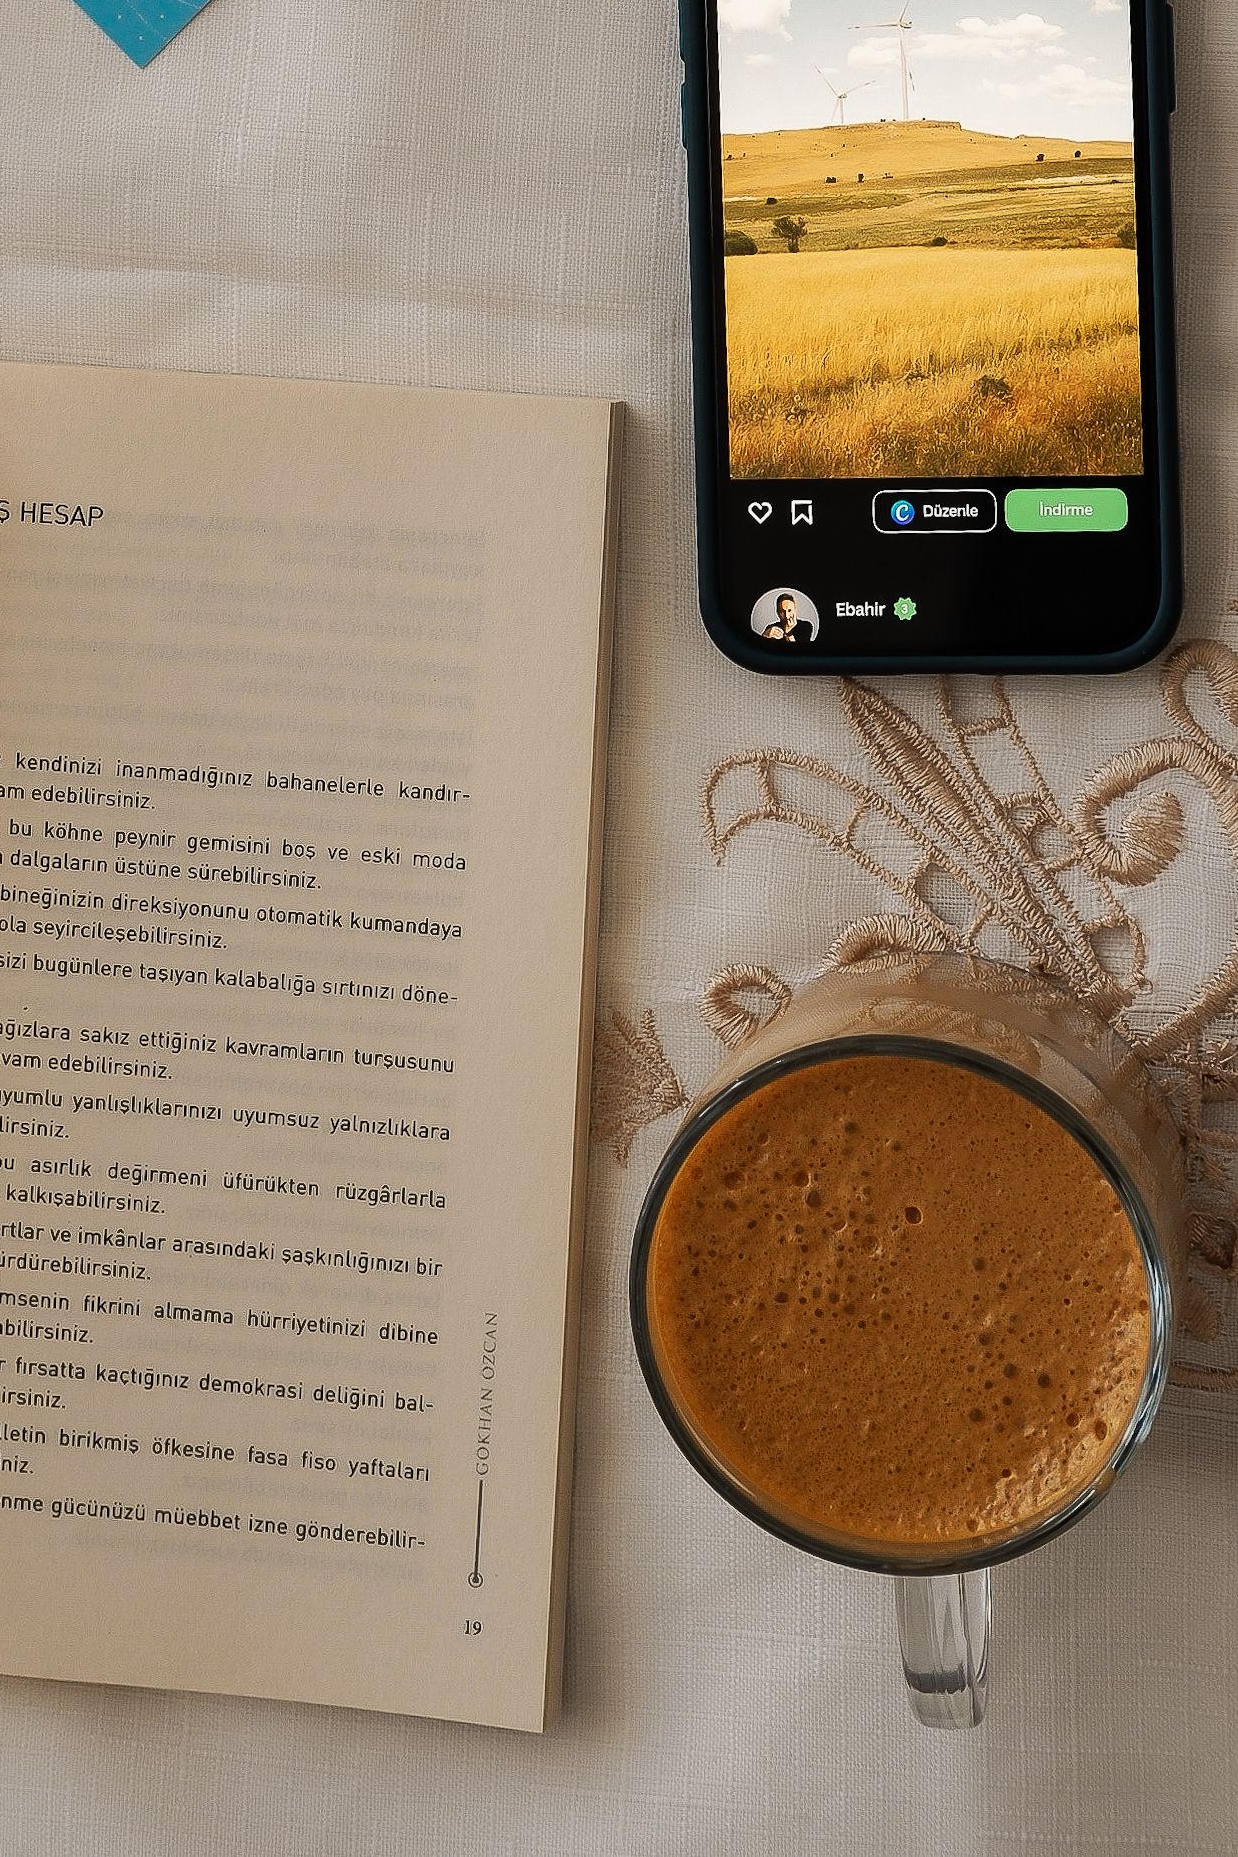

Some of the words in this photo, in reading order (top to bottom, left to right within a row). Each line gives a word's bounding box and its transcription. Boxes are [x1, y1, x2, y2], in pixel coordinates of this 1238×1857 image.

[20, 500, 105, 528] HESAP
[922, 503, 979, 519] Düzenle
[1038, 501, 1094, 517] İndirme
[835, 600, 886, 618] Ebahir
[15, 751, 103, 777] kendinizi
[115, 758, 254, 790] inanmadığınız
[263, 769, 385, 798] bahanelerle
[397, 779, 472, 804] kandır-
[30, 783, 152, 810] edebilirsiniz.
[8, 817, 33, 838] bu
[43, 819, 104, 843] köhne
[110, 830, 178, 851] peynir
[186, 835, 271, 856] gemisini
[281, 837, 317, 862] boş
[326, 846, 350, 862] ve
[360, 845, 401, 866] eski
[411, 851, 467, 872] moda
[8, 847, 109, 874] dalgaların
[113, 858, 182, 879] üstüne
[186, 864, 318, 890] sürebilirsiniz.
[0, 882, 105, 911] bineğinizin
[110, 891, 250, 922] direksiyonunu
[255, 905, 344, 930] otomatik
[349, 910, 463, 943] kumandaya
[31, 918, 228, 950] seyircileşebilirsiniz.
[5, 1182, 166, 1215] kalkışabilirsiniz.
[29, 1157, 93, 1178] asırlık
[106, 1160, 208, 1188] değirmeni
[222, 1171, 320, 1198] üfürükten
[335, 1181, 447, 1210] rüzgârlarla
[49, 1227, 73, 1244] ve
[76, 1227, 168, 1252] imkânlar
[171, 1237, 276, 1262] arasındaki
[280, 1246, 410, 1275] şaşkınlığınızı
[415, 1255, 444, 1277] bir
[58, 1427, 140, 1456] birikmiş
[151, 1435, 236, 1462] öfkesine
[247, 1444, 289, 1468] fasa
[300, 1449, 338, 1472] fiso
[347, 1457, 430, 1483] yaftaları
[464, 1619, 483, 1636] 19
